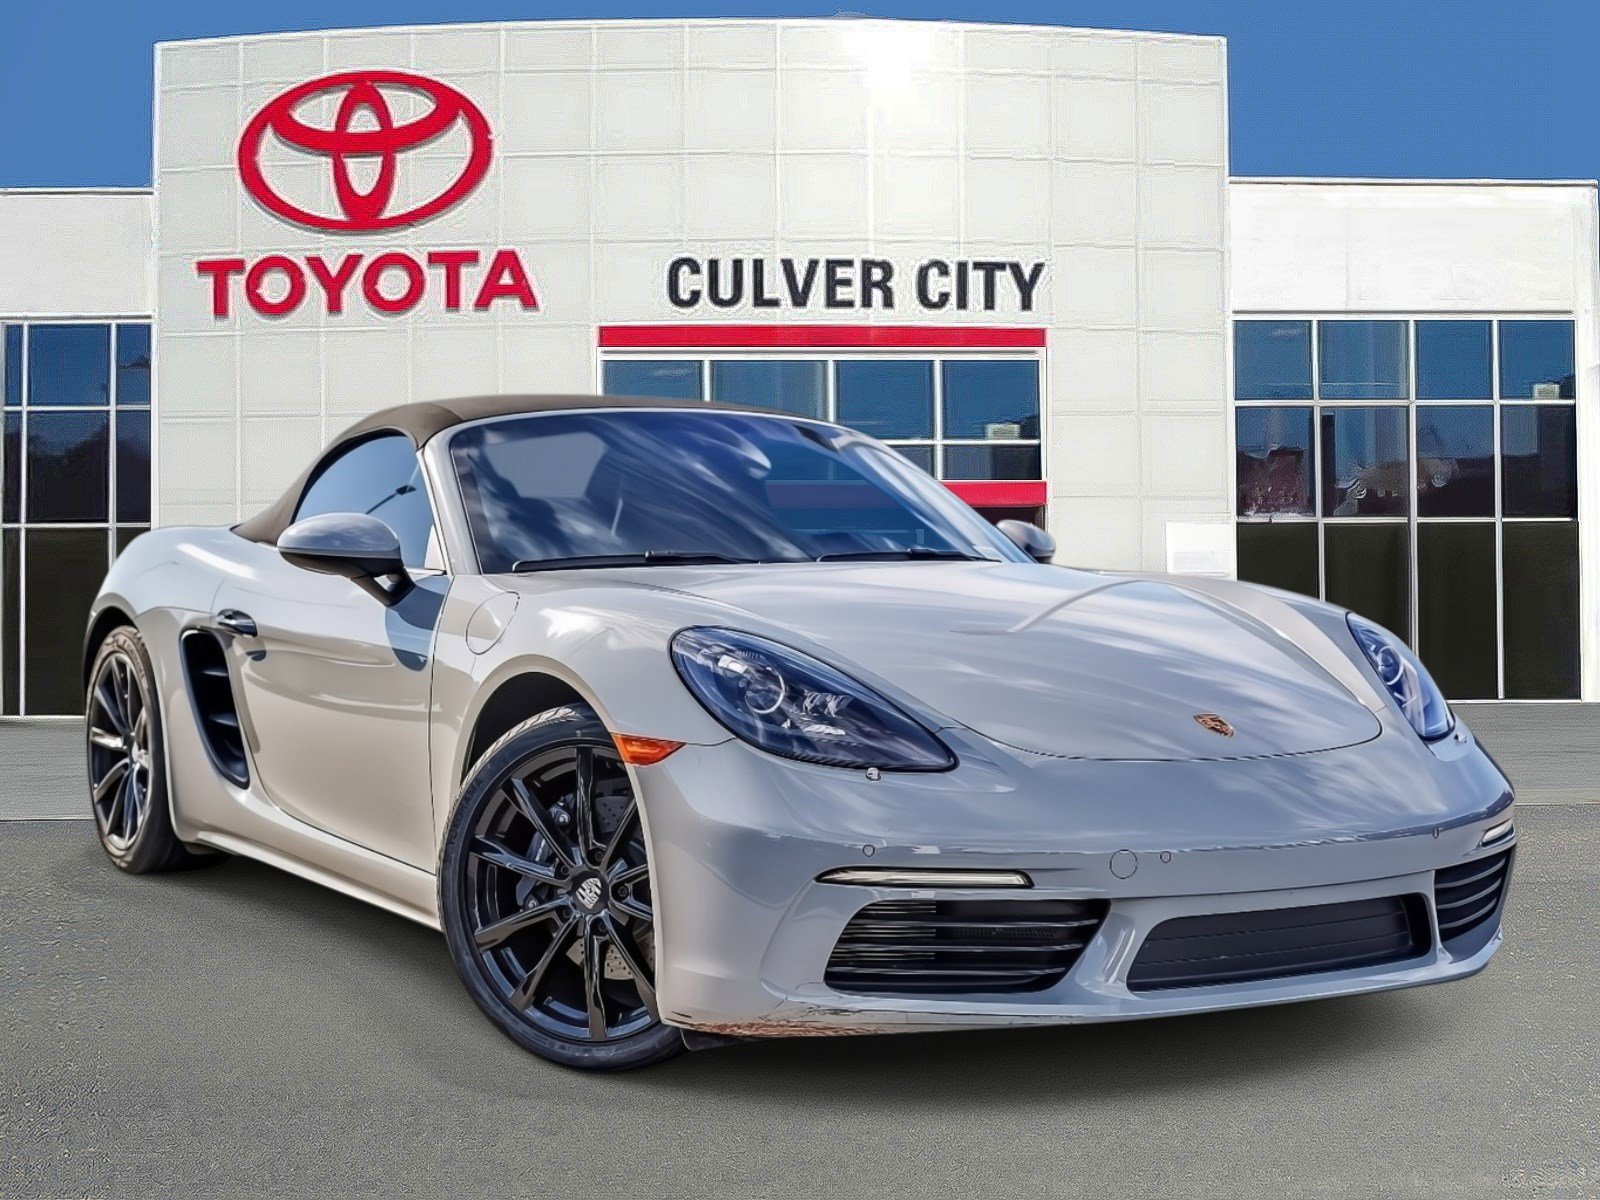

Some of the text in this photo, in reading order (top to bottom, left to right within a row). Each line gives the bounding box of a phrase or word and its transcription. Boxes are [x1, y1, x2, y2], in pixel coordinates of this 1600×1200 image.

[196, 250, 538, 318] TOYOTA
[668, 257, 1045, 312] CULVER CITY
